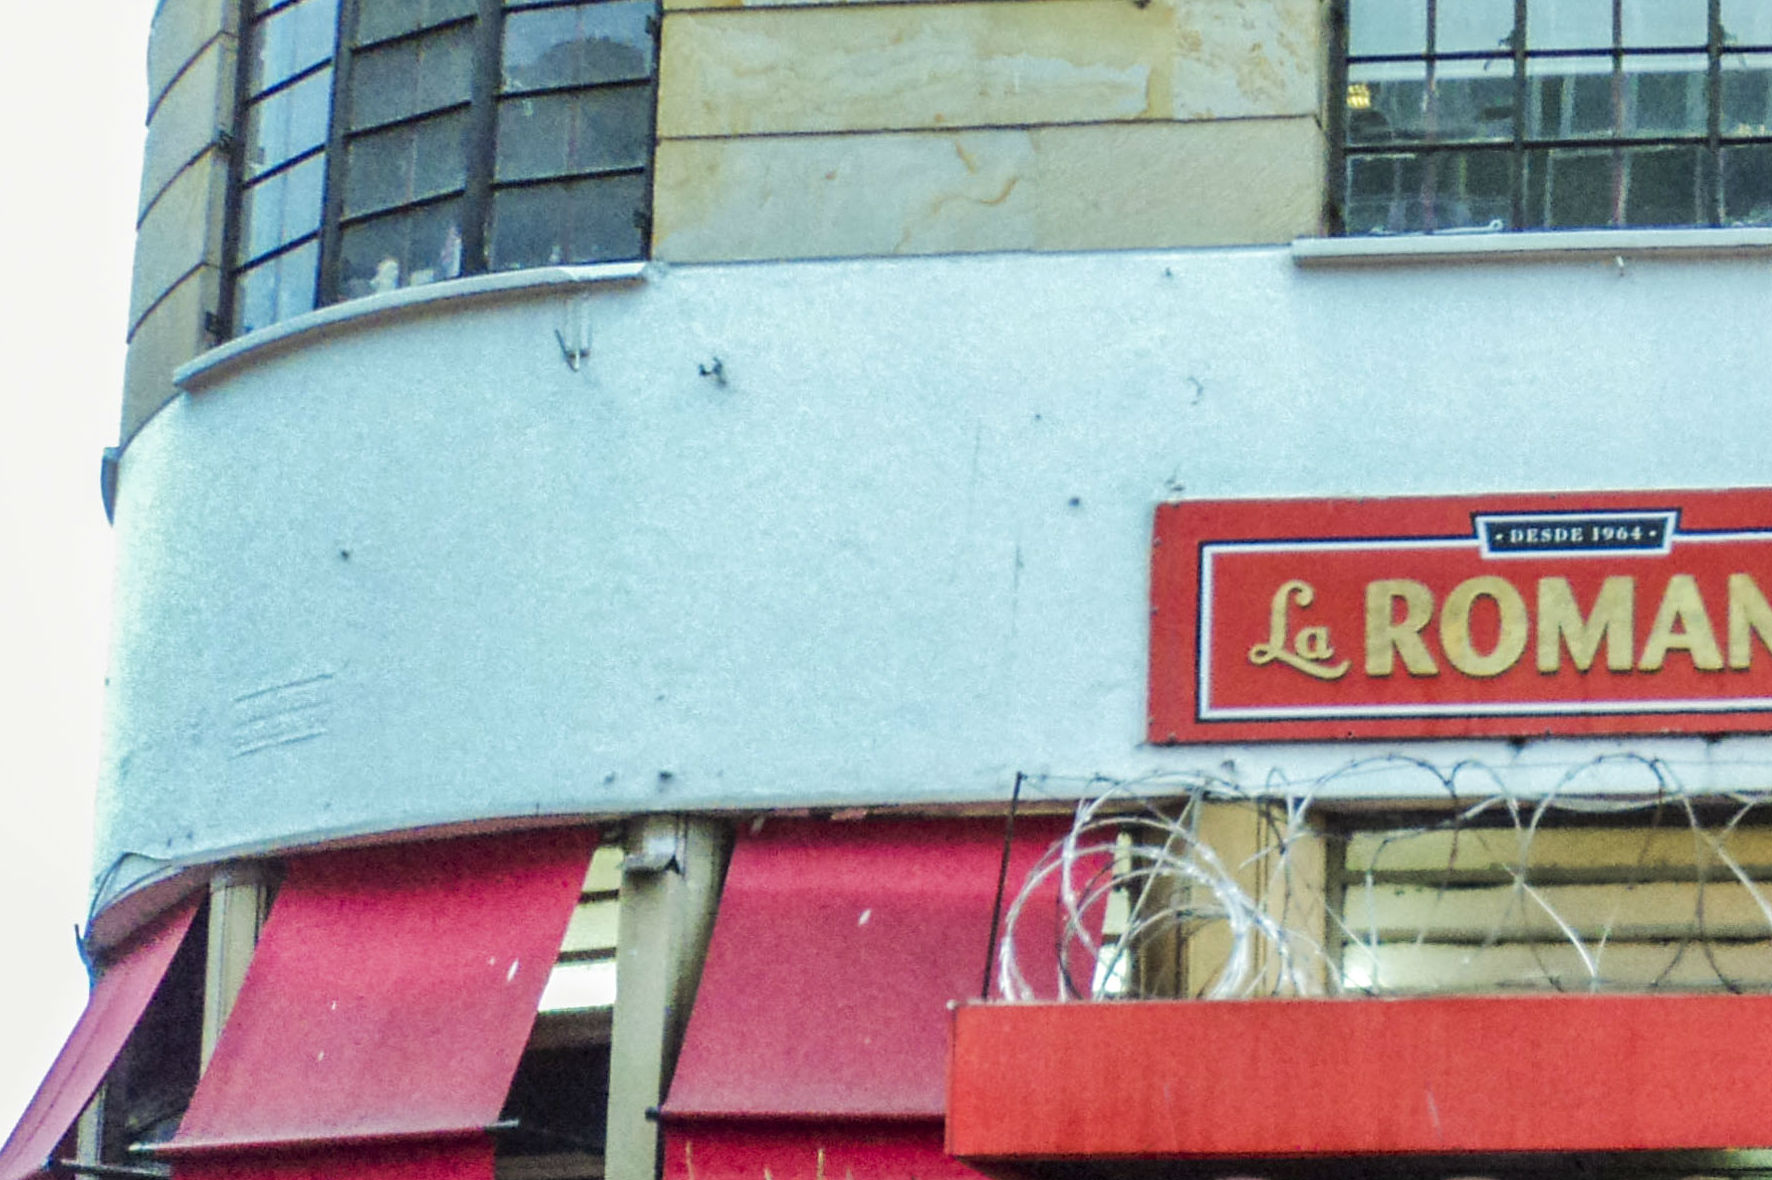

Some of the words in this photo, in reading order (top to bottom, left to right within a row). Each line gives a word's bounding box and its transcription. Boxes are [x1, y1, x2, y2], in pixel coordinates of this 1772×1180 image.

[1510, 527, 1584, 543] DESDE
[1592, 525, 1643, 541] 1964
[1248, 579, 1351, 680] La
